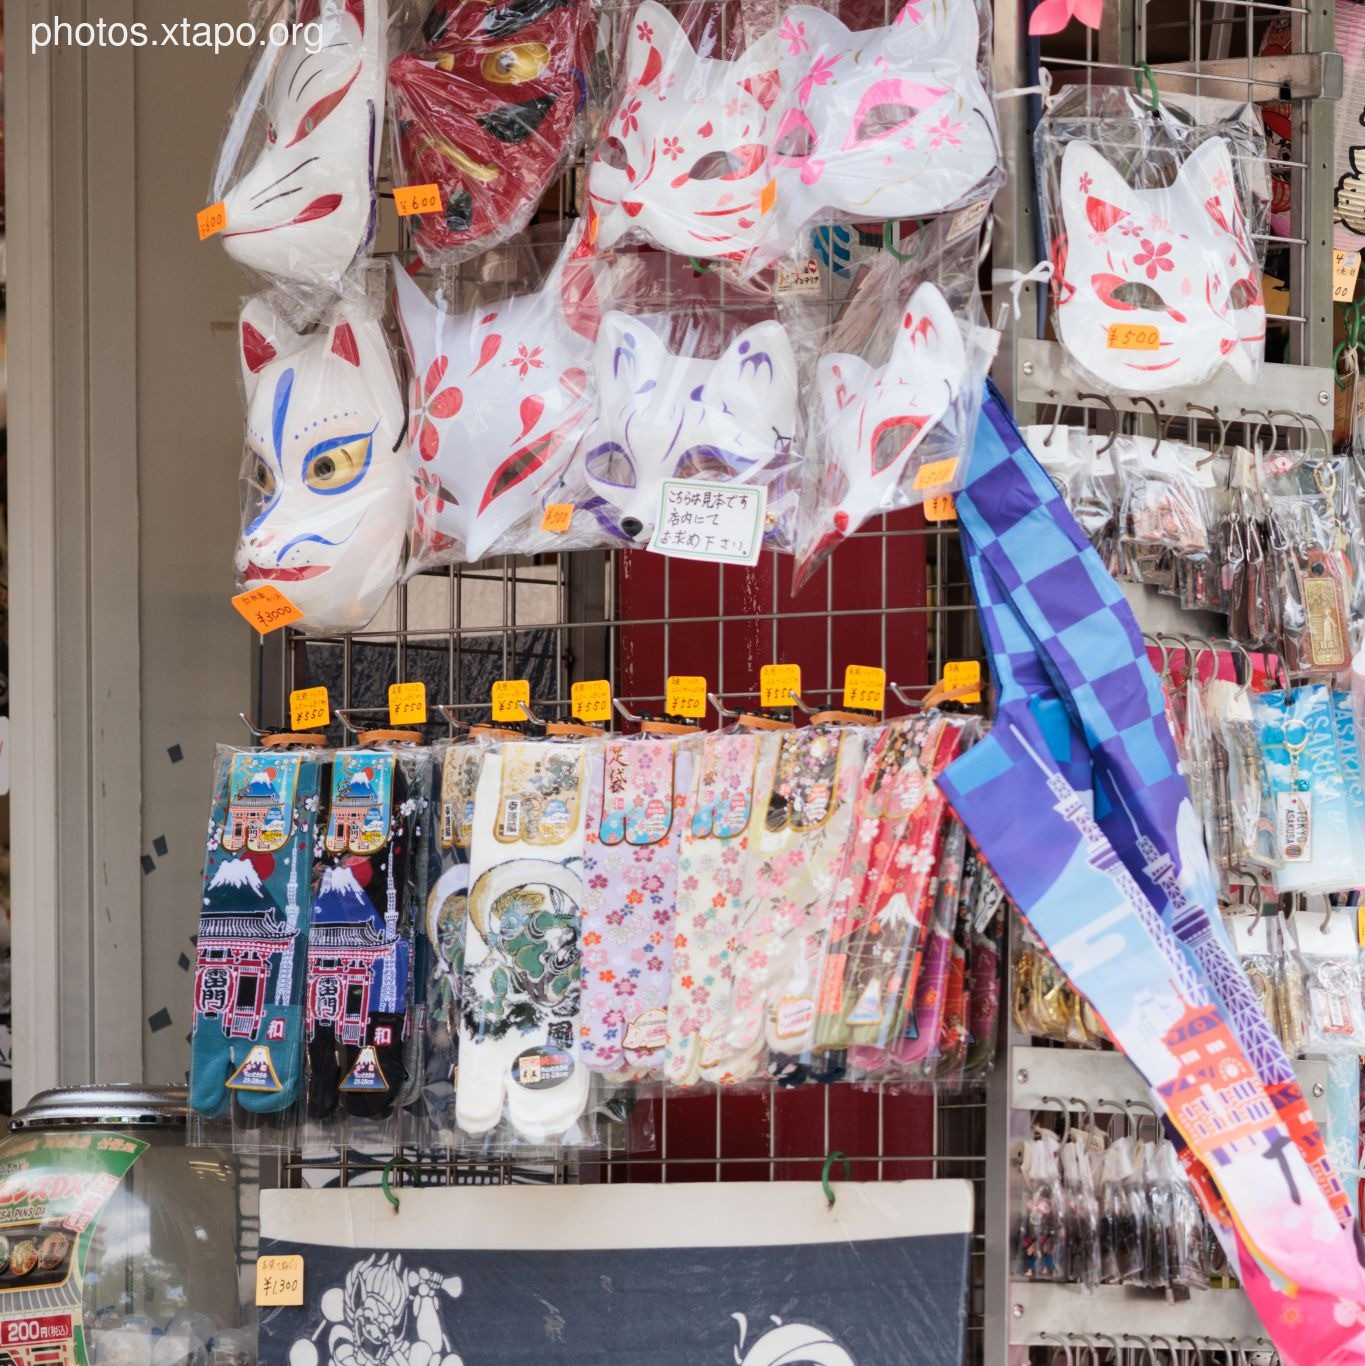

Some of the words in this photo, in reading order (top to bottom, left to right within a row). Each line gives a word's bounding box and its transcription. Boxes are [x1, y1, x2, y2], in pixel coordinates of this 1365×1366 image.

[399, 195, 437, 214] ¥600
[1108, 328, 1159, 347] ¥500
[667, 488, 749, 510] こちらは見本です
[667, 509, 720, 526] 店内にて
[255, 606, 292, 628] ¥3000
[672, 696, 700, 711] ¥550
[850, 687, 882, 702] ¥550
[296, 708, 325, 725] ¥550
[394, 702, 422, 715] ¥550
[576, 700, 608, 714] ¥550
[608, 744, 628, 794] 足袋
[1285, 808, 1295, 844] ASAKUSA
[1297, 810, 1308, 844] TOKYO
[202, 969, 228, 1009] 雷門
[317, 978, 338, 1017] 雷門
[268, 1020, 284, 1039] 和
[373, 1027, 392, 1046] 和
[14, 1207, 34, 1219] PINS
[7, 1320, 69, 1342] 200円(税込)
